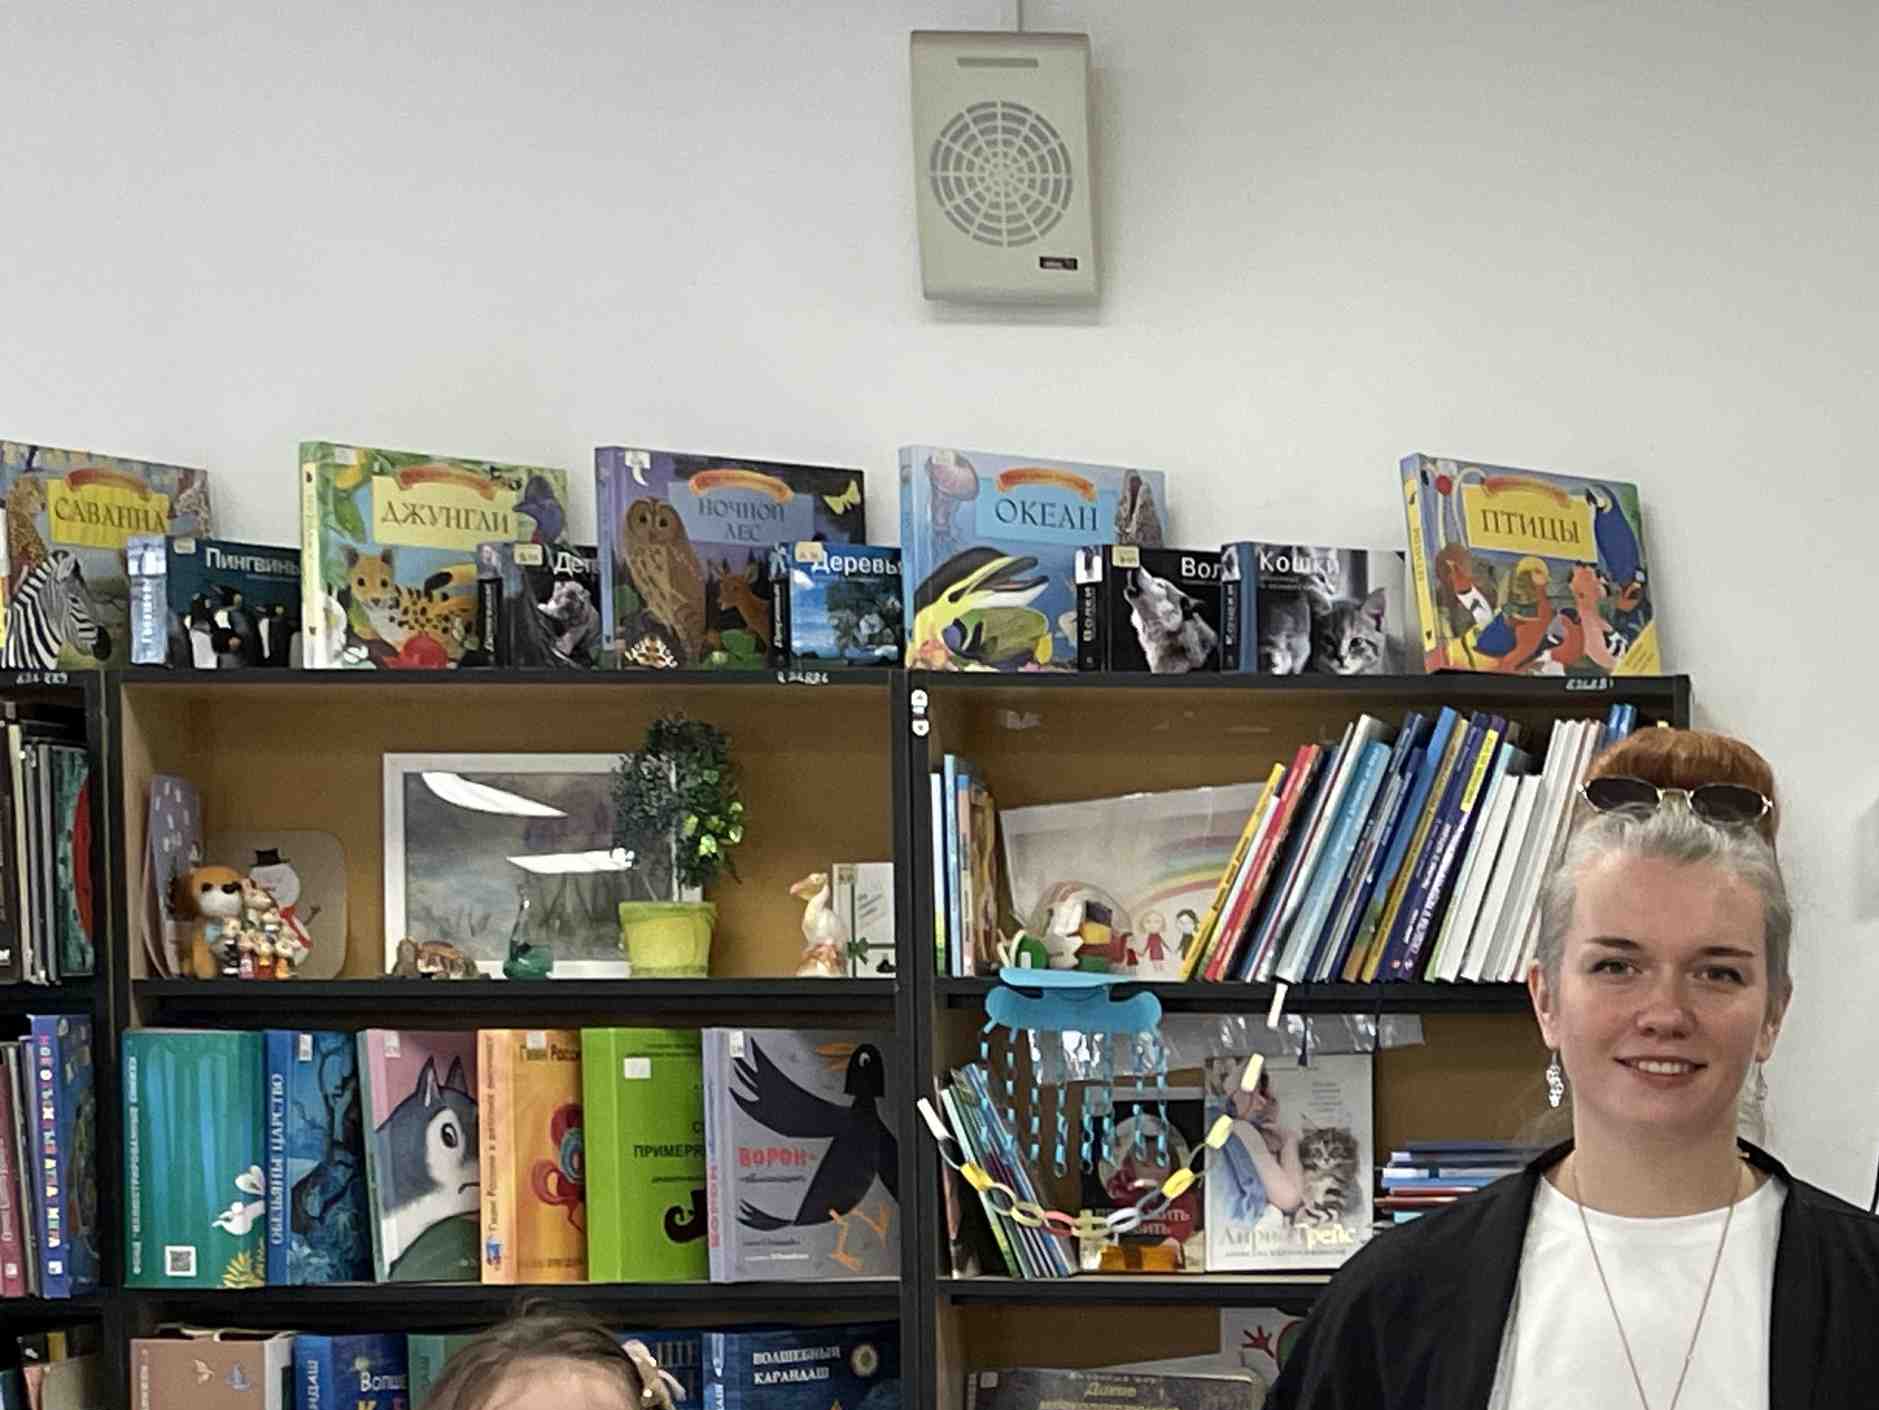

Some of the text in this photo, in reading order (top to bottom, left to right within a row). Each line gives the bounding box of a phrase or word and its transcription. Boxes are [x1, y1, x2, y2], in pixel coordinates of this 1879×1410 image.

[54, 495, 168, 534] САВАННА
[380, 496, 510, 534] ДЖУНГЛИ
[994, 497, 1100, 532] ОКЕАН
[1480, 508, 1581, 545] ПТИЦЫ
[270, 1072, 286, 1152] ЦАРСТВО
[753, 1366, 831, 1385] КАРАНДАШ
